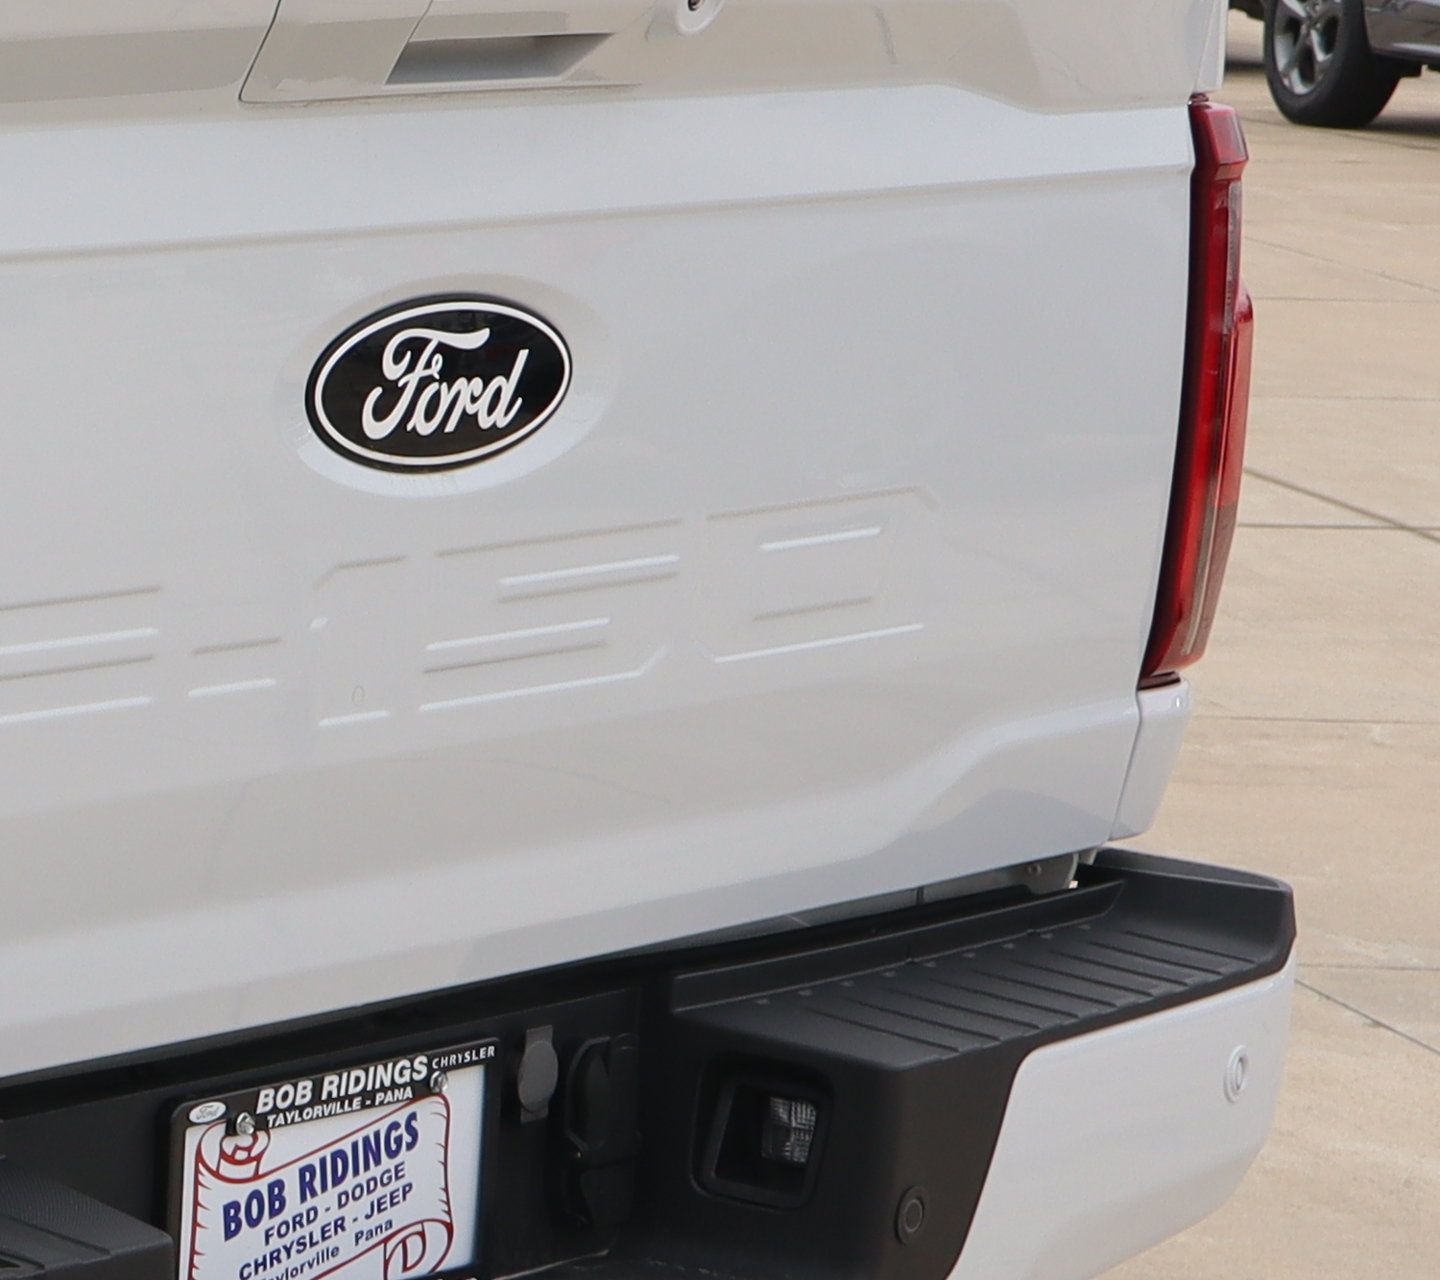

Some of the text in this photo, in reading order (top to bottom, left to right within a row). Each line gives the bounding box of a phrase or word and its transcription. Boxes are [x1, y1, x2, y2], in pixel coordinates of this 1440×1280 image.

[362, 327, 530, 440] Ford
[432, 1045, 496, 1069] CHRYSLER
[255, 1054, 429, 1115] BOB RIDINGS
[266, 1098, 362, 1128] TAYLORVILLE
[376, 1086, 414, 1105] PANA
[222, 1111, 420, 1242] BOB RIDINGS
[364, 1182, 414, 1221] JEEP
[264, 1206, 319, 1246] FORD
[337, 1161, 407, 1211] DODGE
[353, 1219, 394, 1246] Pana
